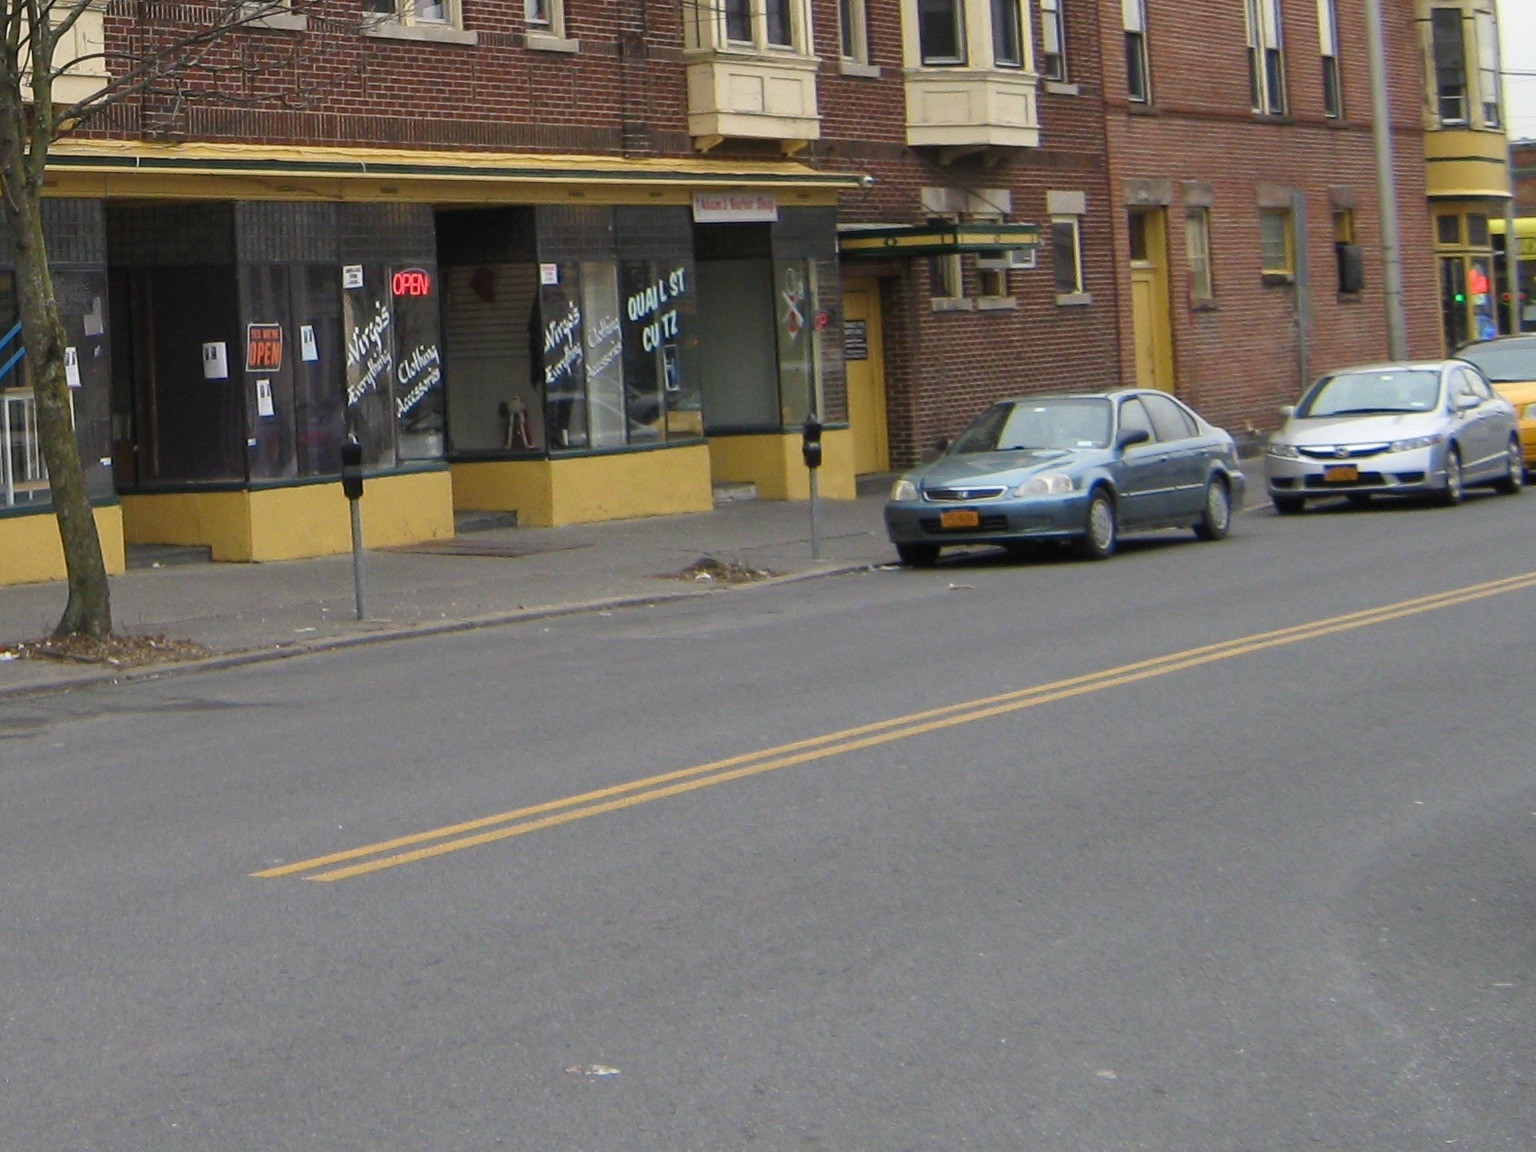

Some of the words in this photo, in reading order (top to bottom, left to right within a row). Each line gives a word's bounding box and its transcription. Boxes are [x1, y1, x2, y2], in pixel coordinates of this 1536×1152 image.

[393, 272, 430, 296] OPEN
[669, 267, 685, 297] ST
[249, 341, 280, 366] OPEN
[398, 345, 440, 384] Clothing
